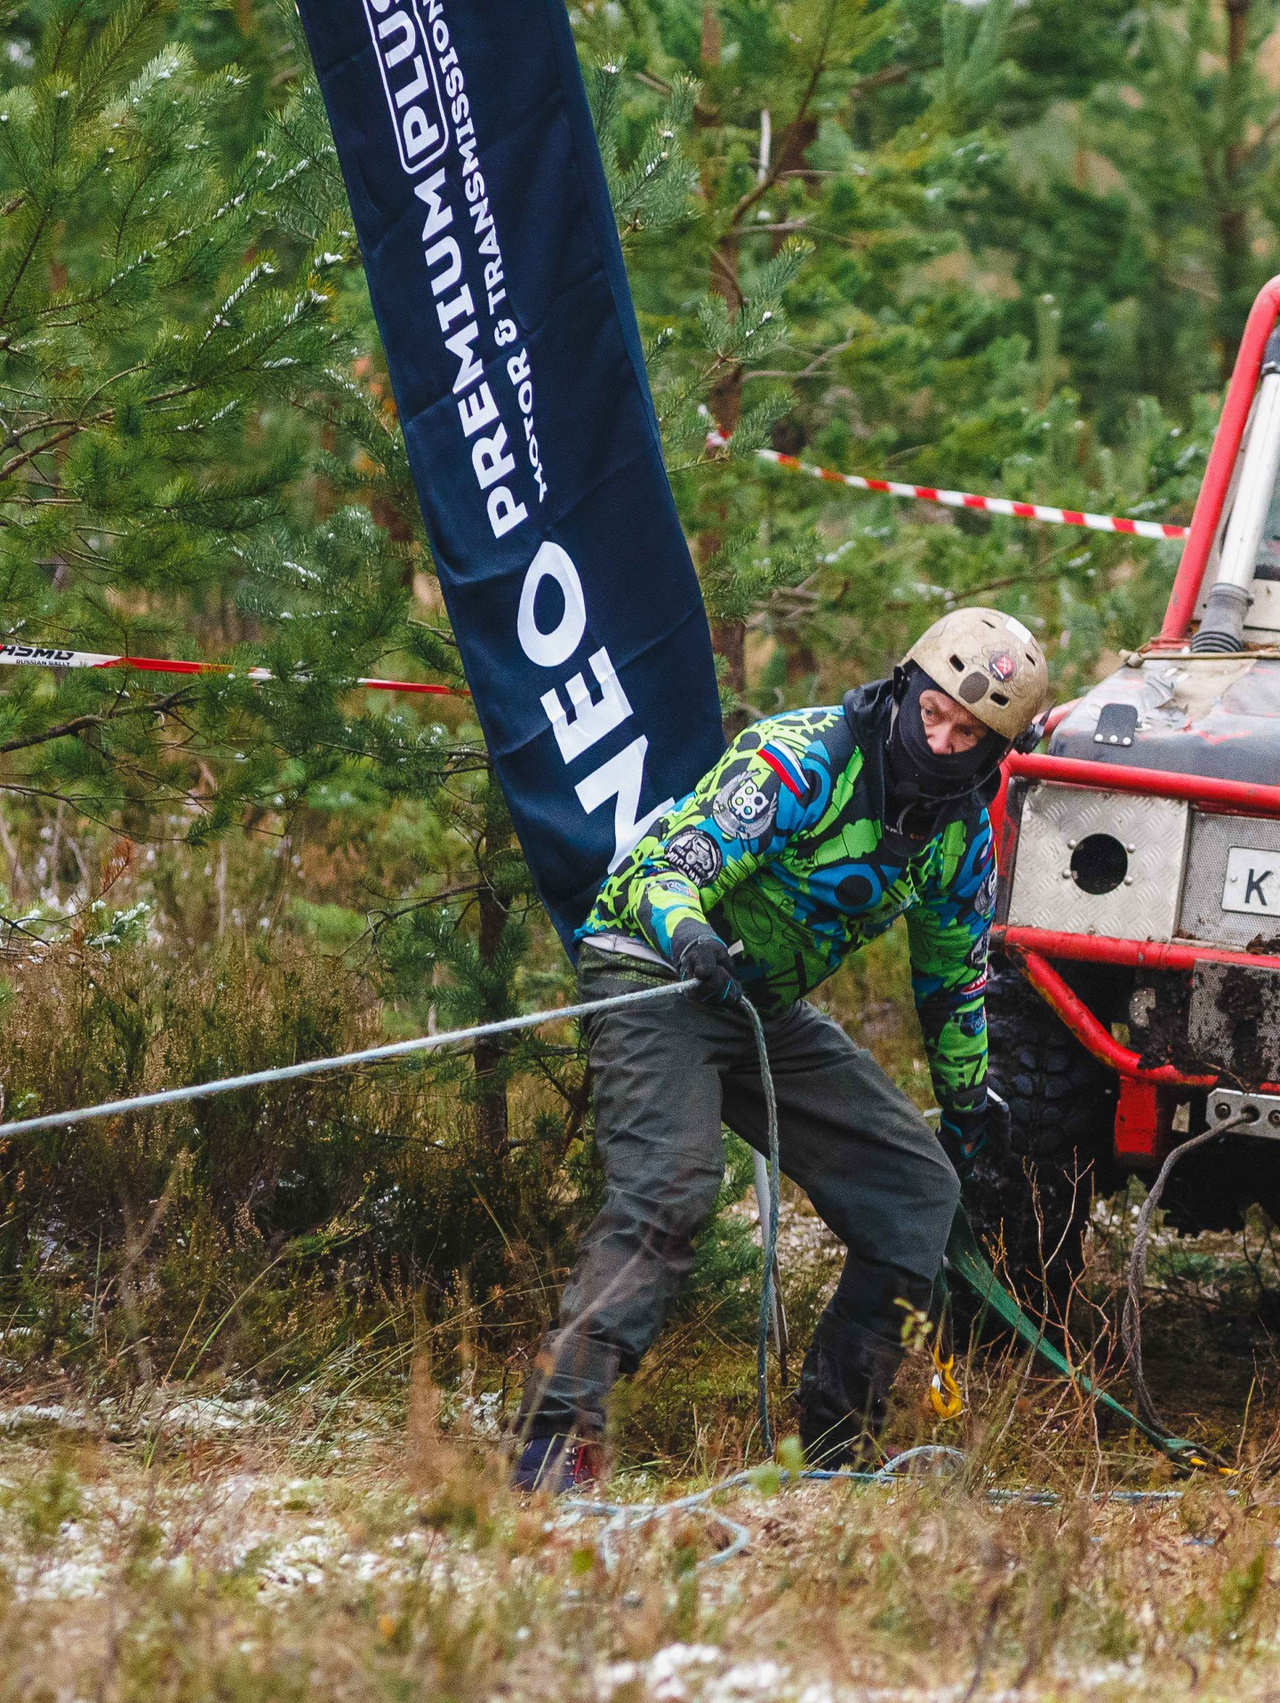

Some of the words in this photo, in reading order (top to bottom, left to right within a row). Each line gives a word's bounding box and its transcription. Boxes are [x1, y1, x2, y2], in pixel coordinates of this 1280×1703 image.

[414, 167, 528, 539] PREMIUM
[494, 318, 518, 347] &
[517, 541, 676, 874] NEO
